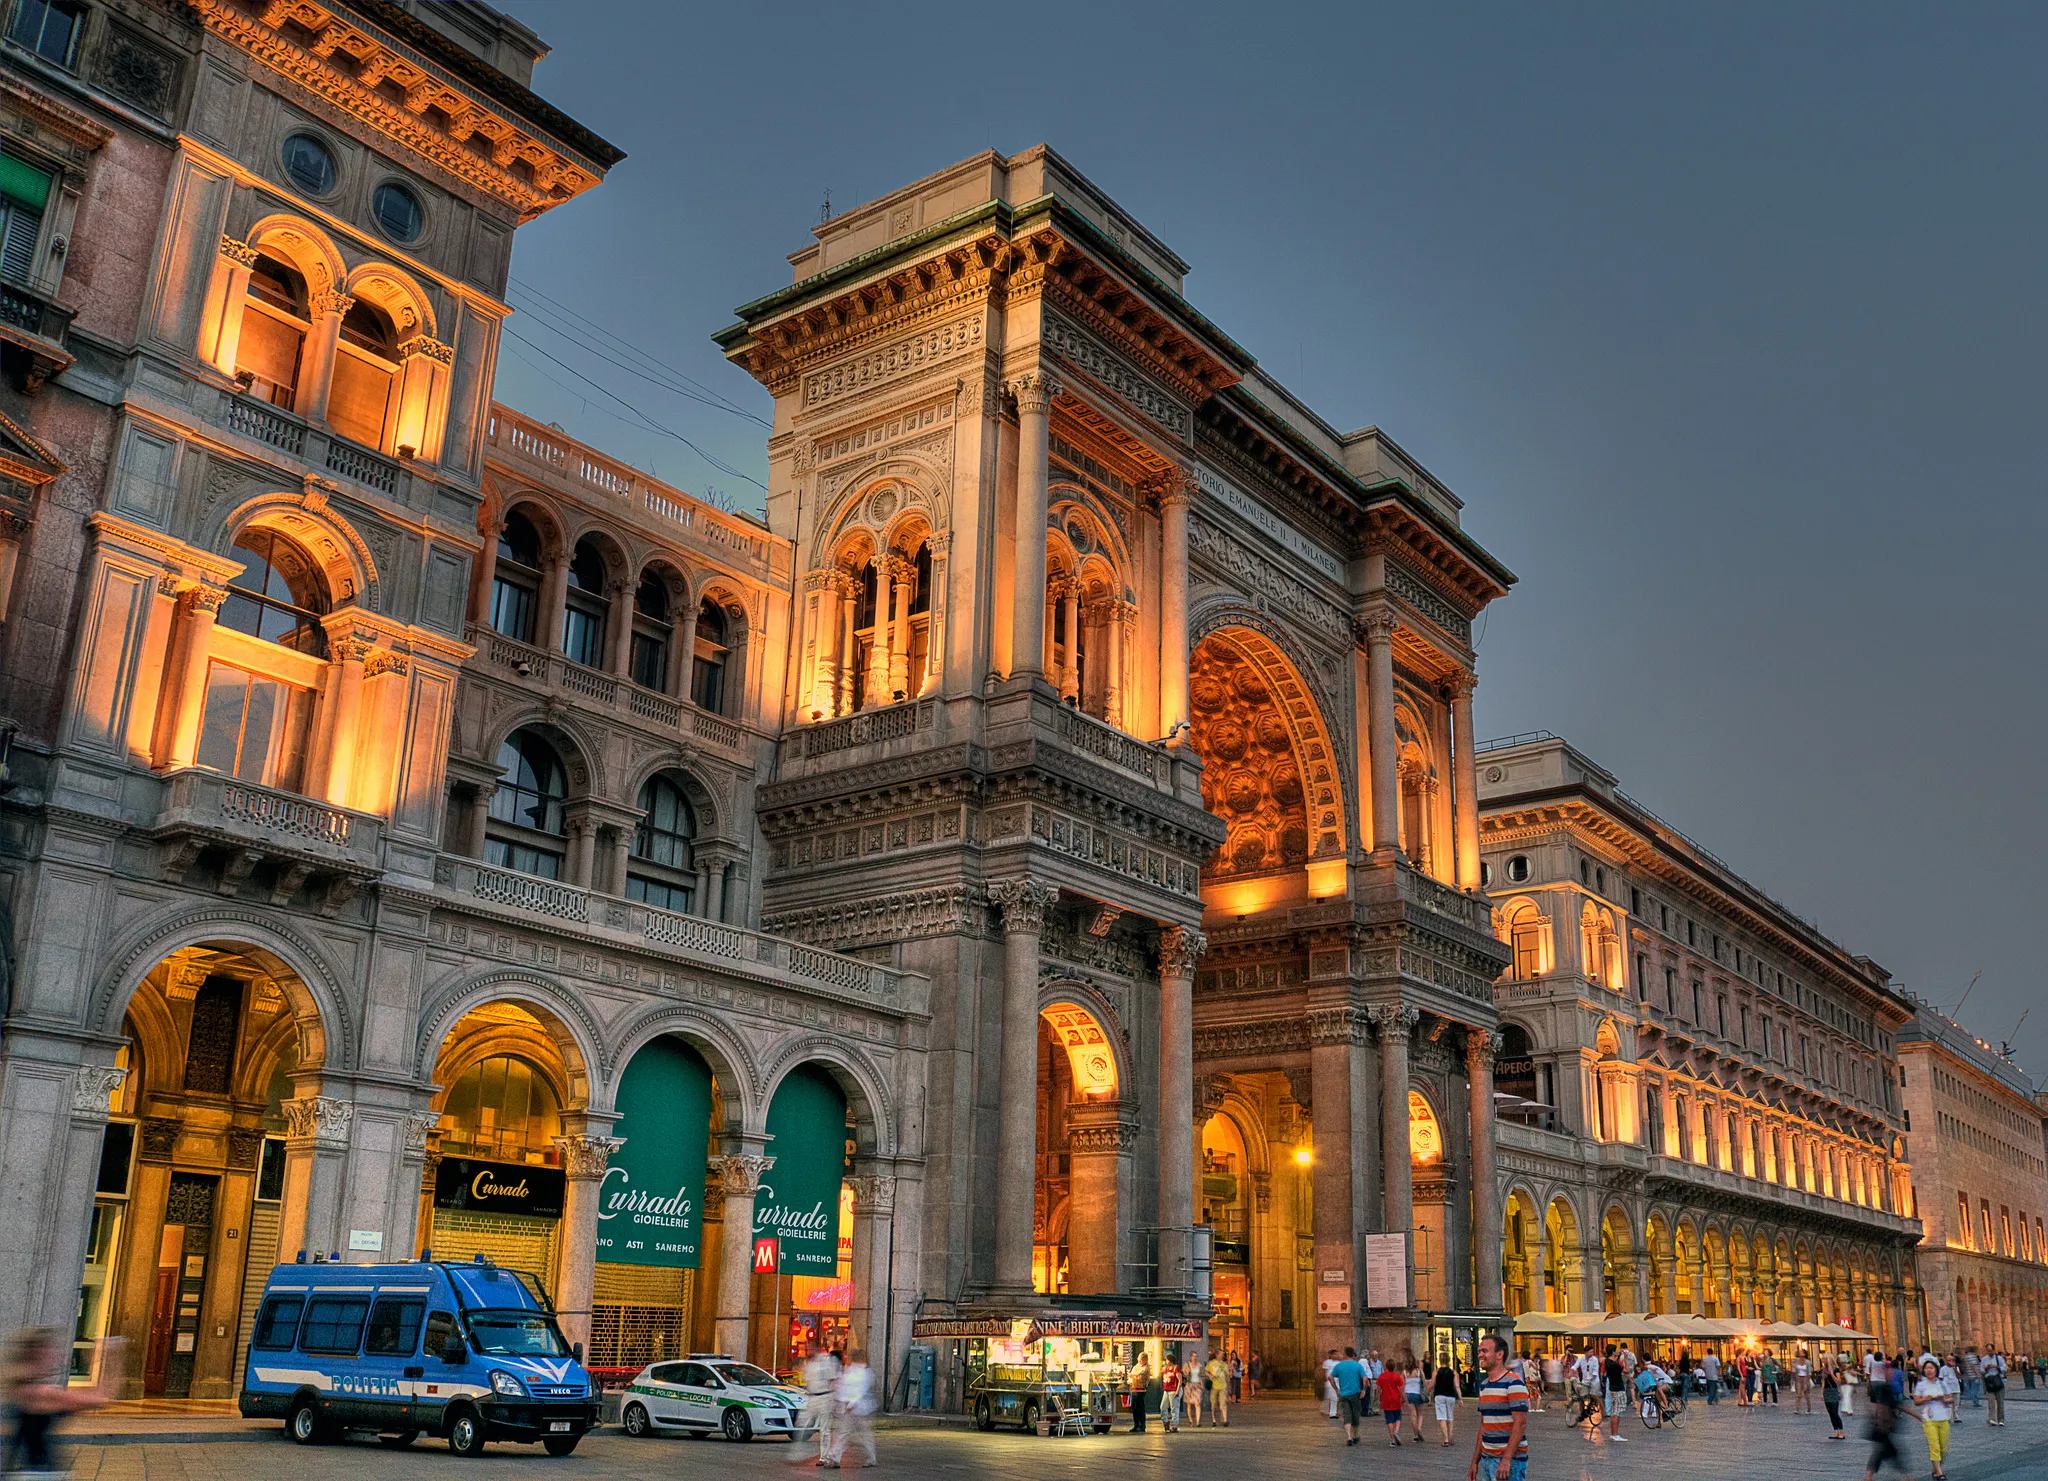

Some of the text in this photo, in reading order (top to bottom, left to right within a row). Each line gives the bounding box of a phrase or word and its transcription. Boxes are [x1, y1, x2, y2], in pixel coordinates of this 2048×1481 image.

[1229, 490, 1277, 533] EMANUELE
[1301, 541, 1337, 575] MILANESI
[471, 1170, 530, 1200] Currado
[598, 1167, 692, 1220] Currado
[633, 1214, 690, 1229] GIOIELLERIE
[777, 1227, 827, 1241] GIOIELLERIE
[626, 1240, 644, 1250] ASTI
[655, 1242, 695, 1253] SANREMO
[755, 1245, 774, 1267] M
[796, 1253, 832, 1264] SANREMO
[1071, 1321, 1108, 1335] BIBITE
[1163, 1322, 1195, 1337] PIZZA
[332, 1375, 399, 1396] POLIZIA
[689, 1394, 712, 1403] LOCALE
